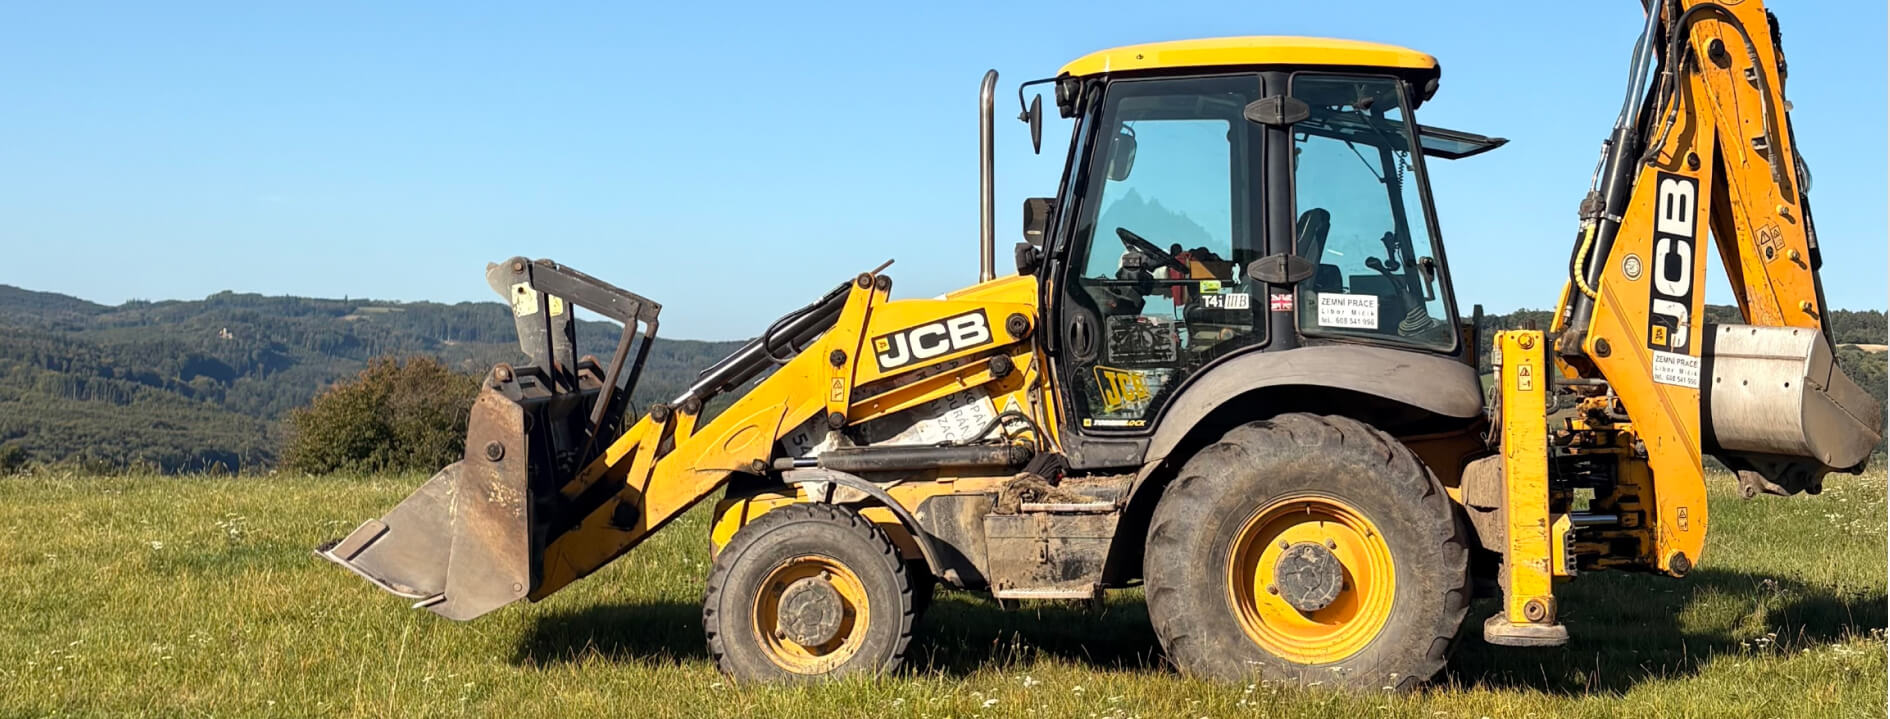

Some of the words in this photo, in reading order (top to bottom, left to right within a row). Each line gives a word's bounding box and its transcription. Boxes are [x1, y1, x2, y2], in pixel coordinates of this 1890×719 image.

[1653, 178, 1695, 347] JCB
[878, 312, 990, 369] JCB
[1103, 370, 1147, 406] JCB
